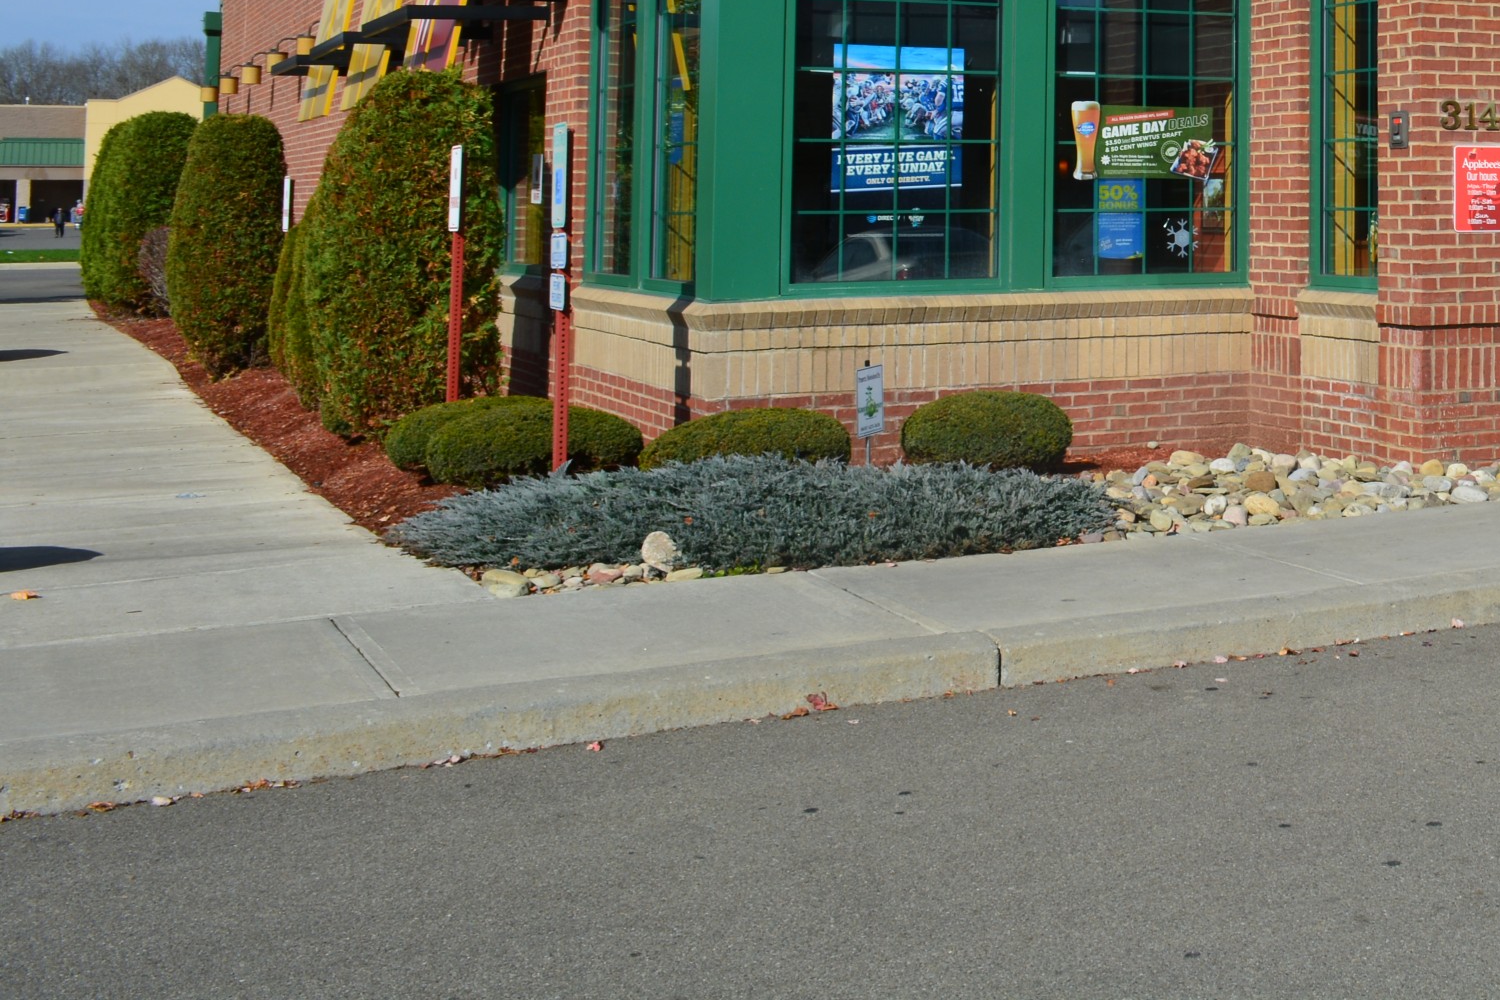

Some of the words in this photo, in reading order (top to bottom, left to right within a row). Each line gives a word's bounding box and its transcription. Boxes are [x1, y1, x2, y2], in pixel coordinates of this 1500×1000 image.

[1102, 123, 1139, 139] GAME
[1142, 120, 1167, 134] DAY
[1168, 114, 1209, 130] DEALS
[1105, 138, 1121, 147] $3.50
[1120, 143, 1135, 151] CENT
[1137, 141, 1158, 149] WINGS
[846, 164, 891, 176] EVERY
[1466, 171, 1478, 181] Our
[1099, 185, 1138, 200] 50%
[1099, 201, 1138, 210] BONUS
